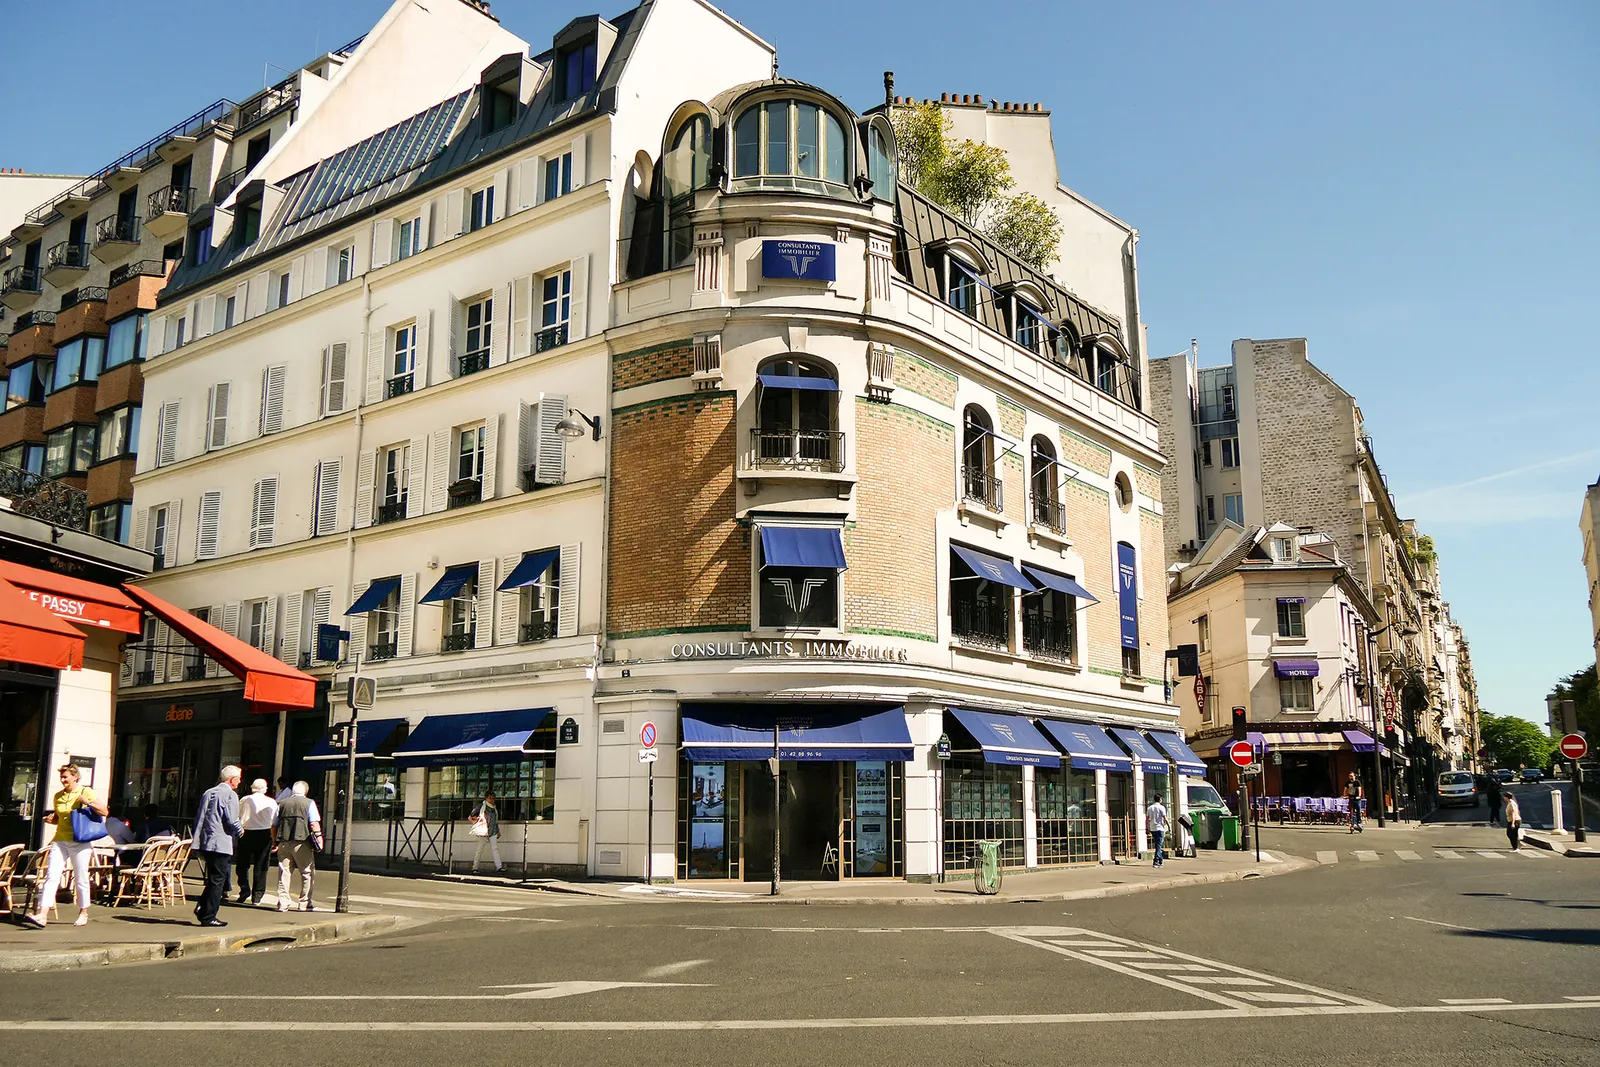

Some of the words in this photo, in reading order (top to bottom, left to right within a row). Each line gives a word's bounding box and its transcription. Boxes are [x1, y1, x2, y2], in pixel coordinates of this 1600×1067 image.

[778, 242, 820, 250] CONSULTANTS
[41, 594, 85, 616] PASSY
[671, 641, 794, 657] CONSULTANTS
[805, 641, 908, 661] IMMOBILIER
[1385, 690, 1393, 720] TABAC
